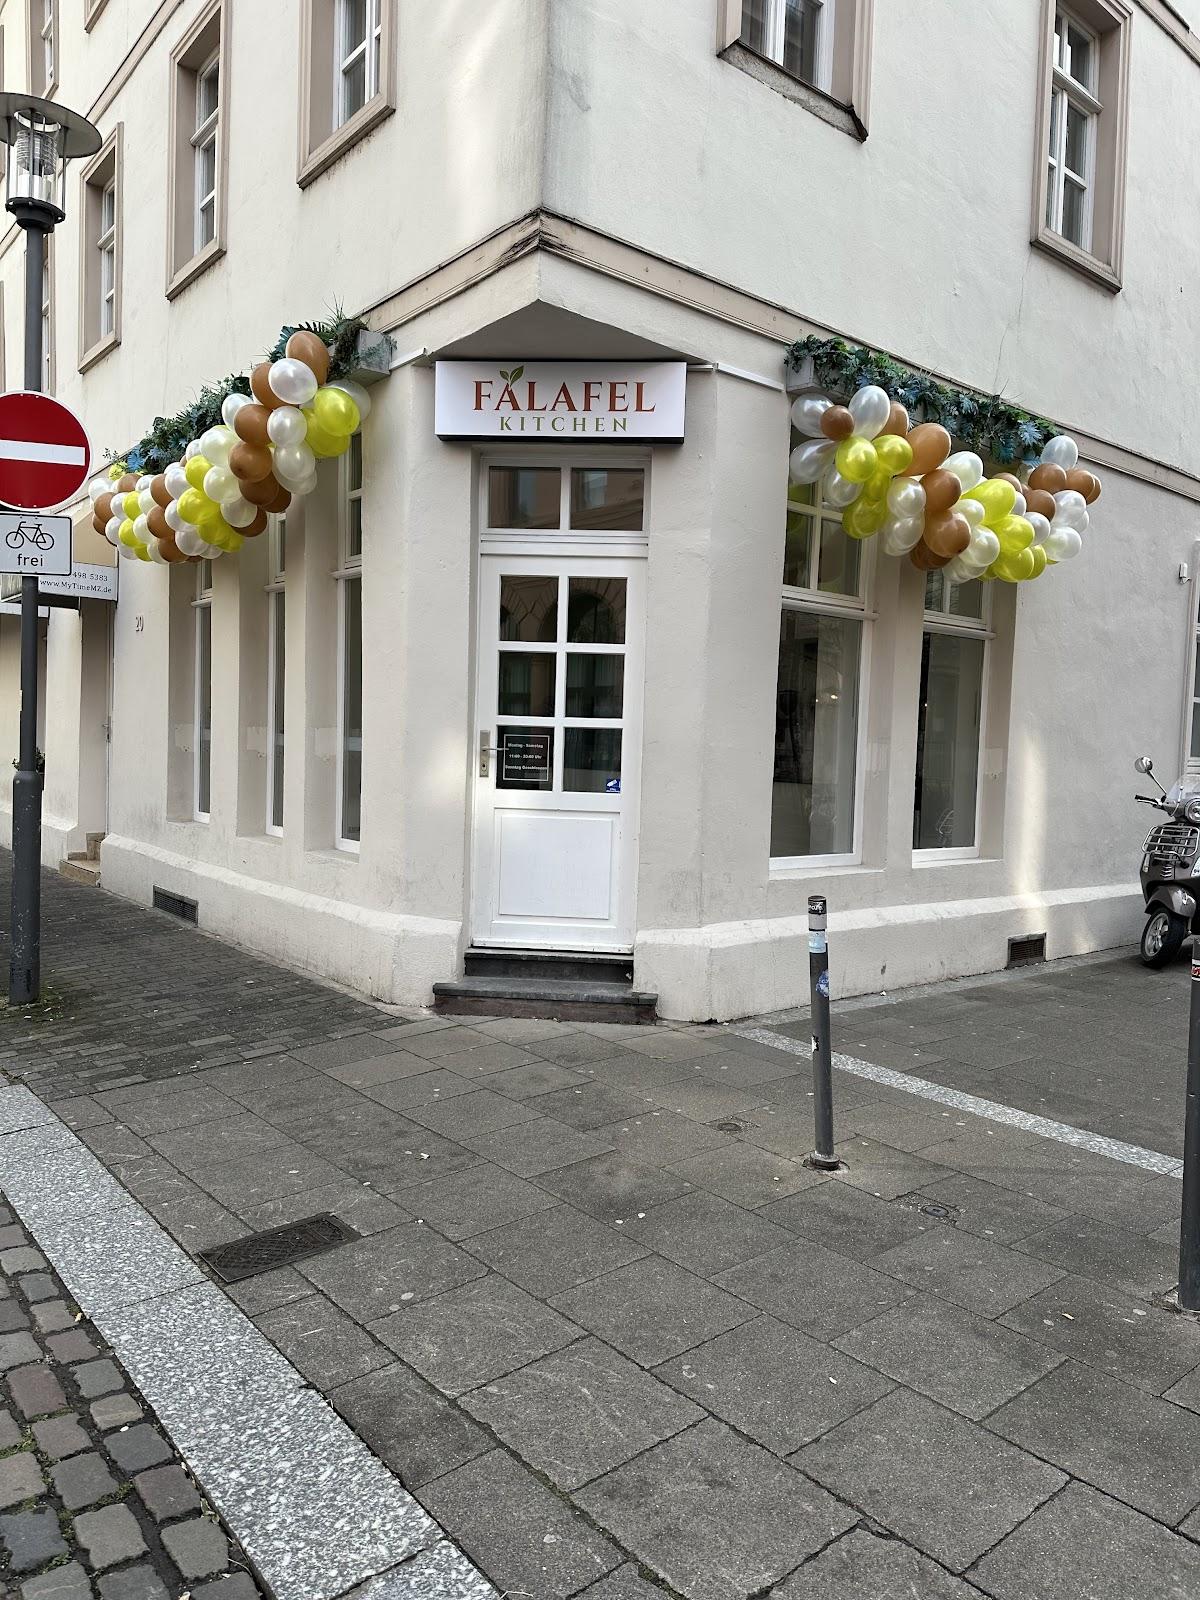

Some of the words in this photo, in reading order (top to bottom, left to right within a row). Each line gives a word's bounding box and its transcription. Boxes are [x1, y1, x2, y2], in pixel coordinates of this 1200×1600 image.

[472, 380, 656, 412] FALAFEL
[499, 416, 628, 432] KITCHEN
[17, 553, 43, 567] frei
[72, 571, 87, 579] 498
[89, 572, 108, 582] 5383
[40, 580, 112, 594] www.MyTimeMZ.de
